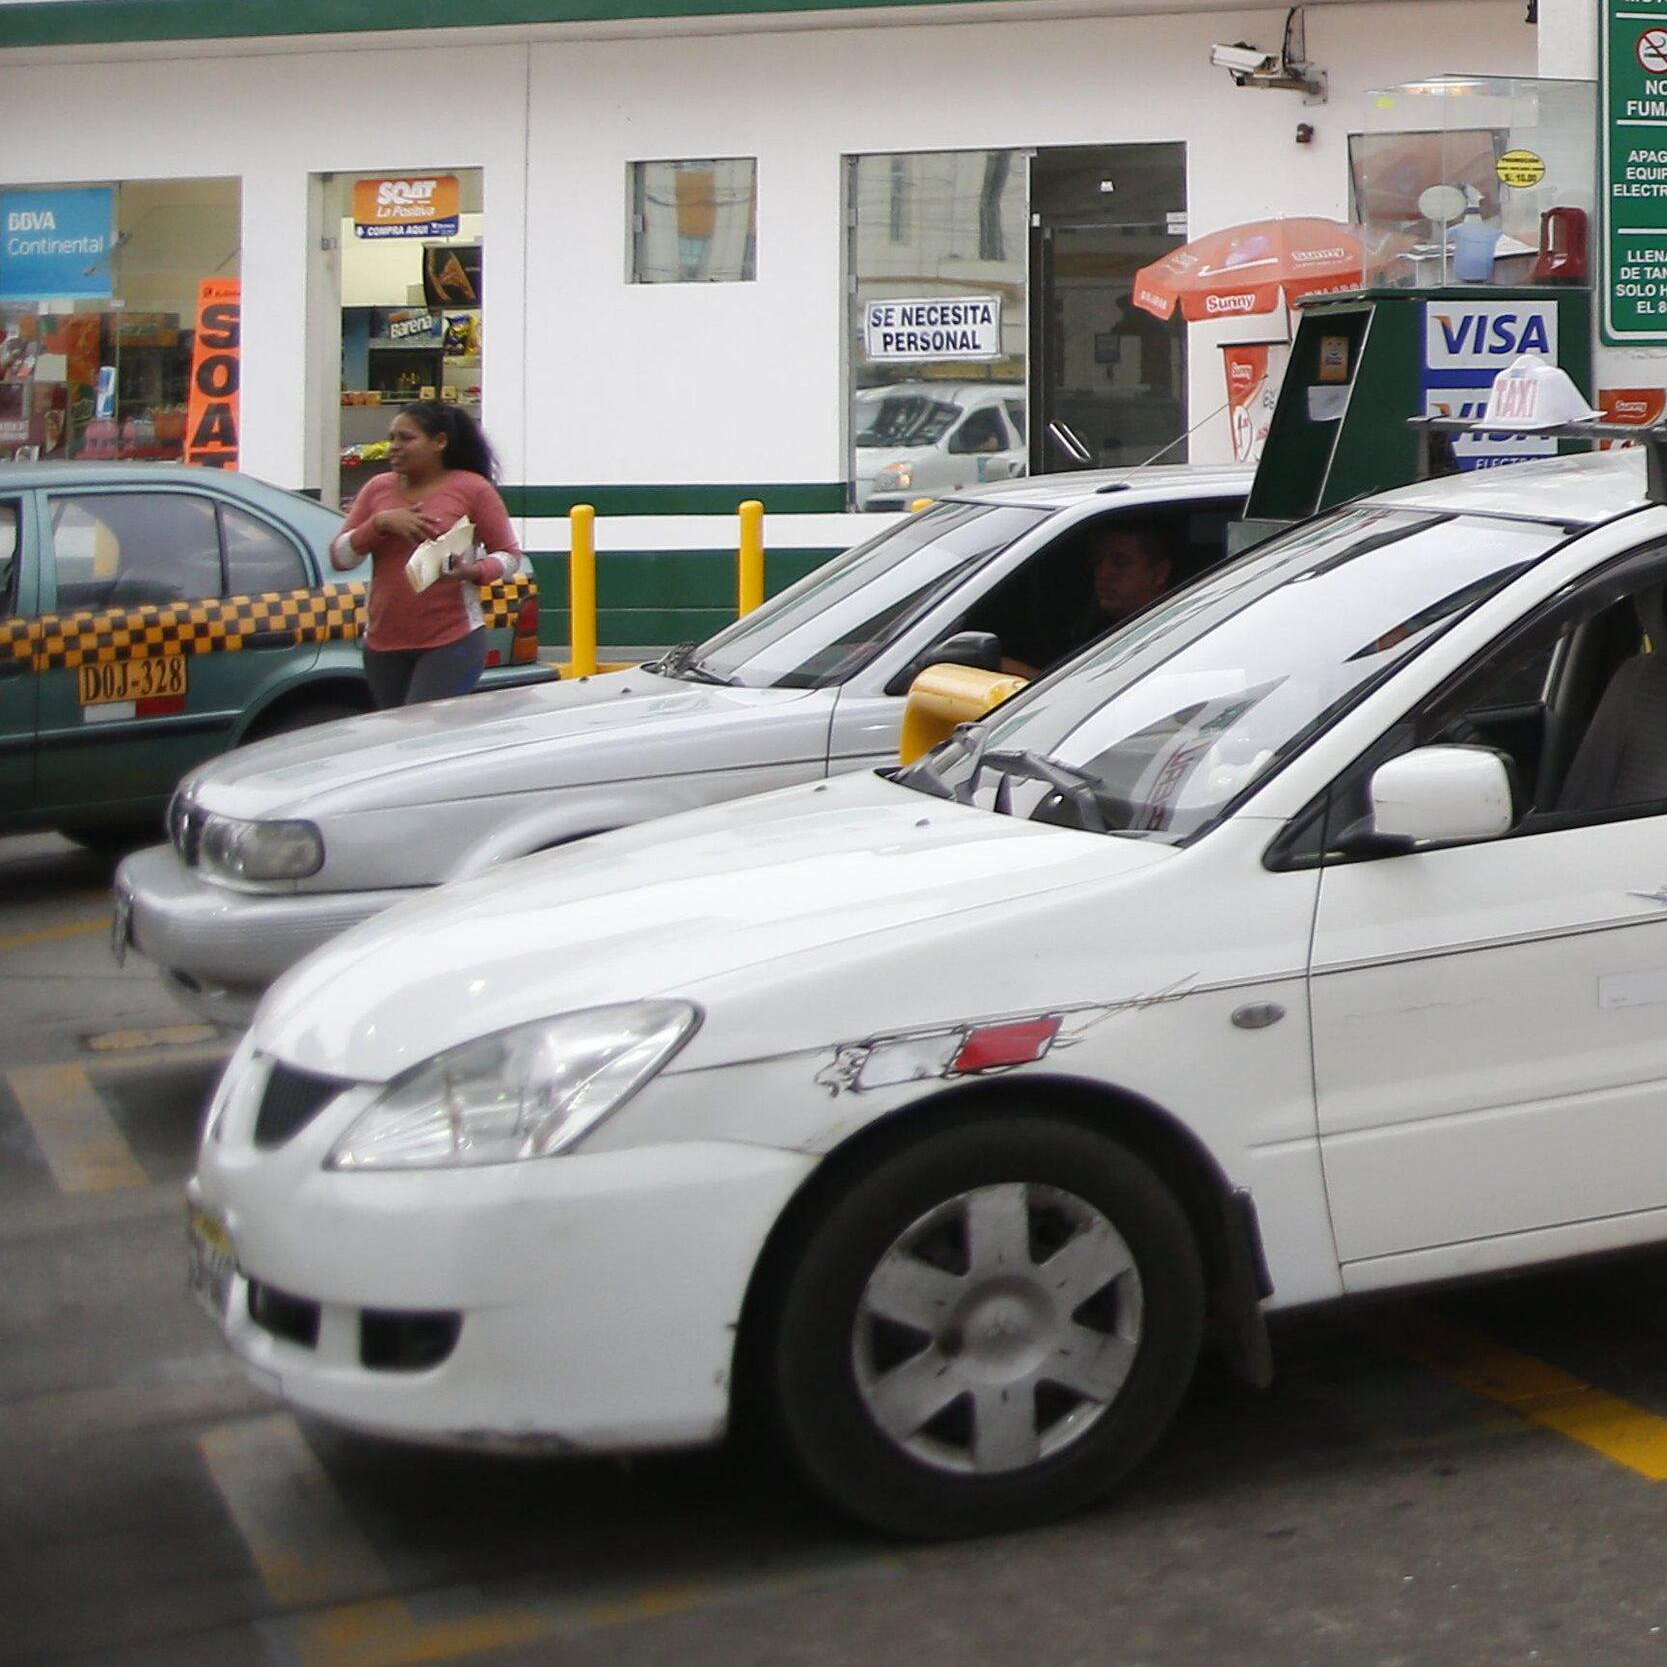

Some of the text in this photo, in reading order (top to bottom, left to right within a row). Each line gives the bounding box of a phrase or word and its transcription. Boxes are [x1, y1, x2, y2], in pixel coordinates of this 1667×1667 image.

[8, 212, 56, 230] BBVA
[8, 236, 103, 254] Continental
[1620, 267, 1640, 280] DE
[1616, 284, 1656, 297] SOLO
[1206, 294, 1255, 313] Sunny
[1637, 301, 1655, 314] EL
[871, 304, 992, 328] SE NECESITA
[882, 328, 981, 352] PERSONAL
[1431, 315, 1549, 354] VISA
[1495, 379, 1537, 418] TAXI
